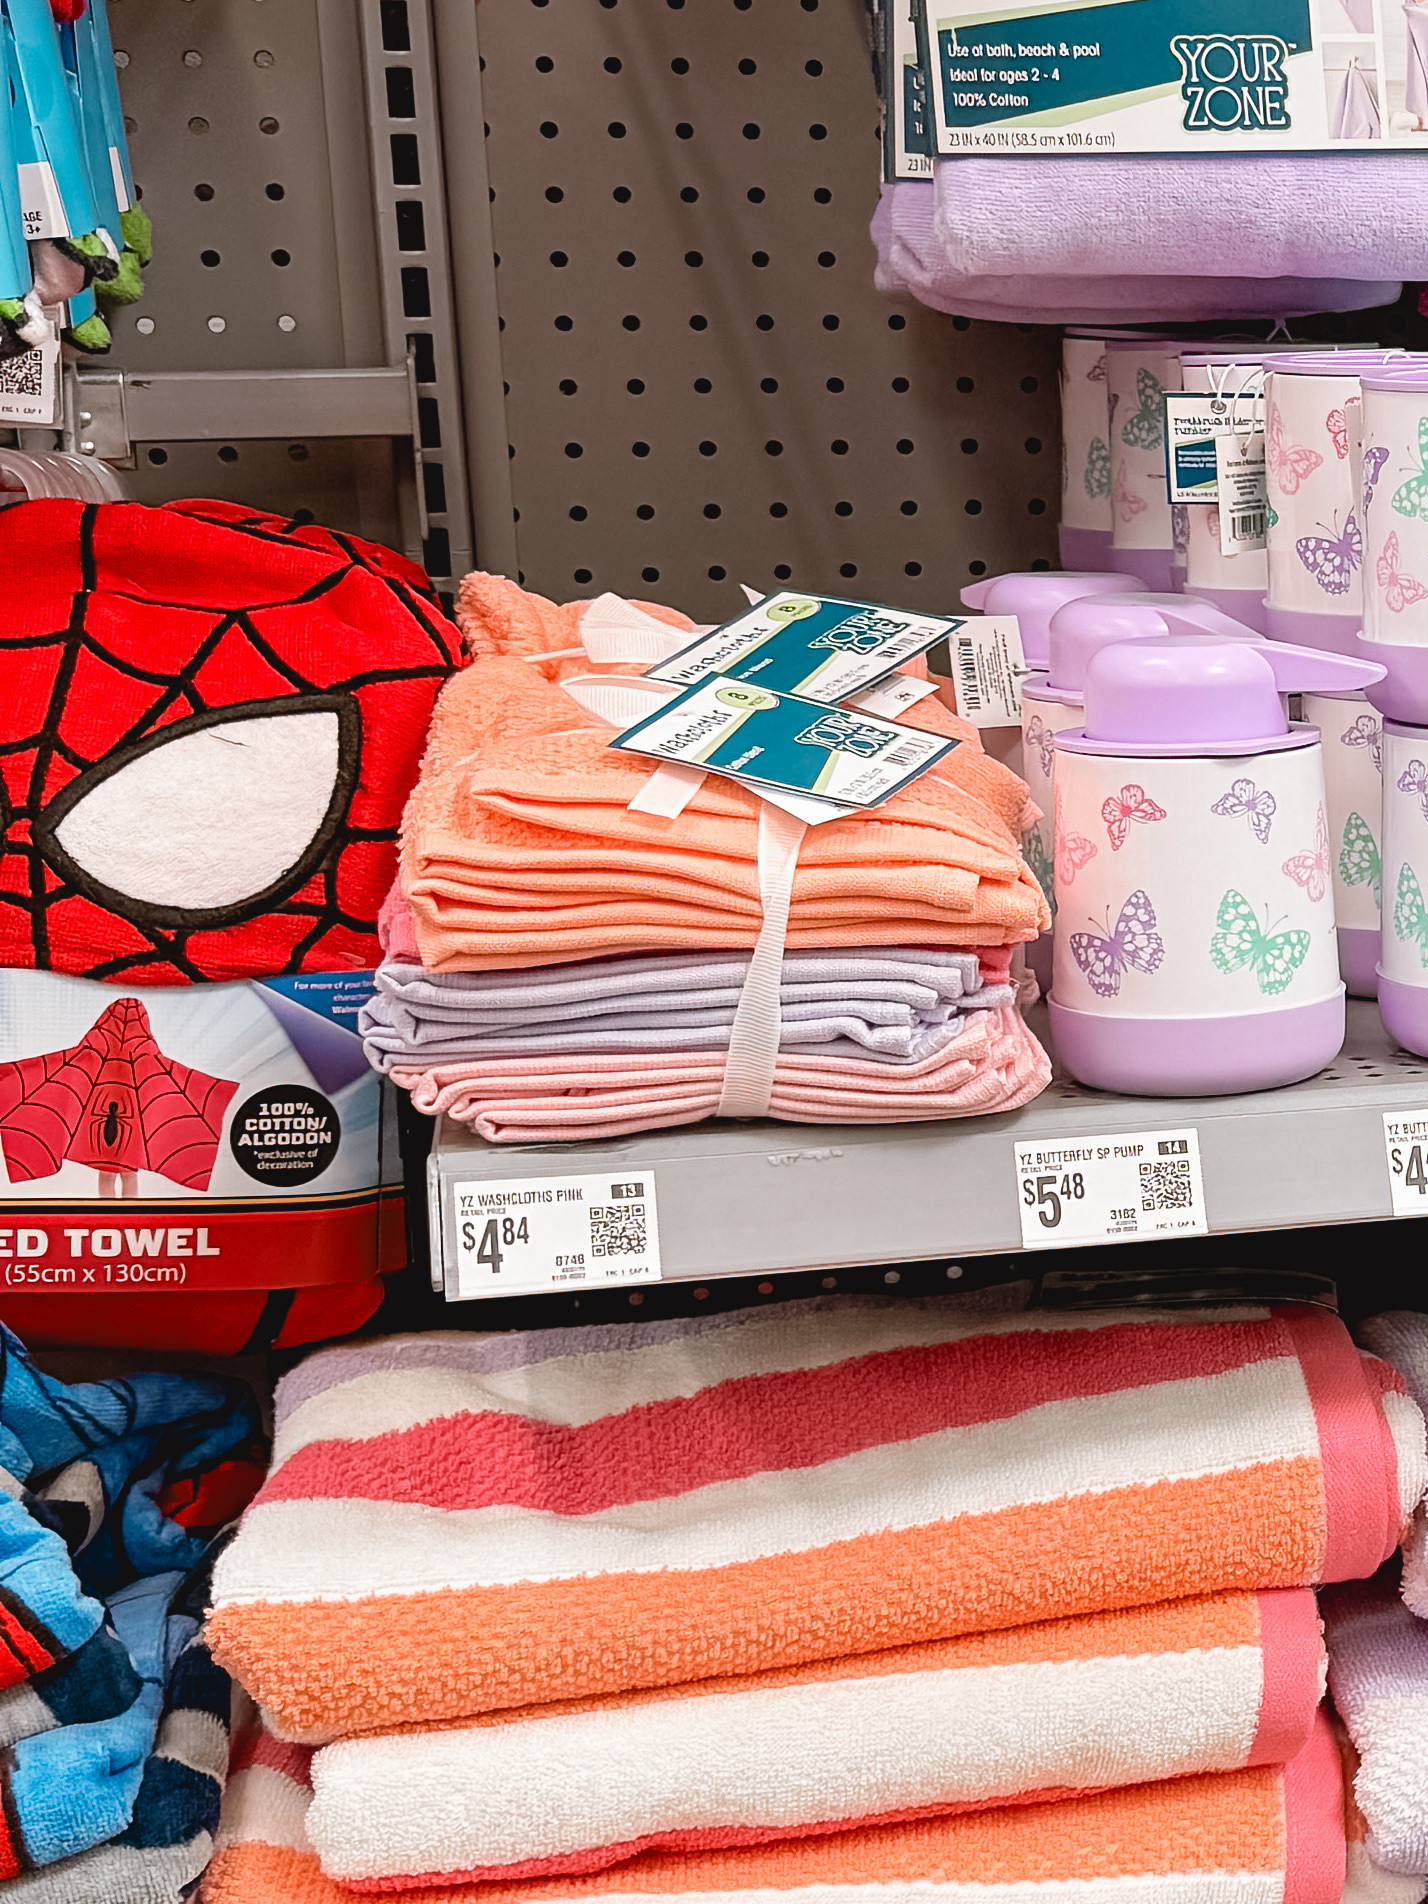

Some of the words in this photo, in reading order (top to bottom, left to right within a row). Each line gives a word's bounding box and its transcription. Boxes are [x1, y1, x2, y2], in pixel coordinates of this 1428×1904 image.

[948, 42, 968, 58] Use
[1018, 41, 1055, 59] beach
[1059, 42, 1069, 58] &
[1072, 42, 1100, 60] pool
[1178, 42, 1282, 82] YOUR
[949, 67, 979, 84] Ideal
[981, 68, 996, 84] for
[999, 68, 1028, 86] ages
[1031, 67, 1040, 83] 2
[1050, 67, 1060, 82] 4
[953, 92, 985, 108] 100%
[988, 92, 1029, 108] Cotton
[1188, 87, 1286, 127] ZONE
[259, 1103, 314, 1115] 100%
[245, 1117, 327, 1131] COTTON/
[238, 1132, 331, 1146] ALGODON
[1020, 1152, 1034, 1166] YZ
[1036, 1148, 1093, 1164] BUTTERFLY
[1098, 1147, 1111, 1160] SP
[1116, 1144, 1144, 1158] PUMP
[1164, 1142, 1181, 1153] 14
[460, 1193, 475, 1210] YZ
[479, 1189, 553, 1206] WASHCLOTHS
[556, 1186, 584, 1203] PINK
[620, 1185, 637, 1197] 13
[65, 1227, 220, 1257] TOWEL
[5, 1264, 77, 1284] (55cm
[83, 1268, 95, 1282] x
[104, 1263, 186, 1283] 130cm)
